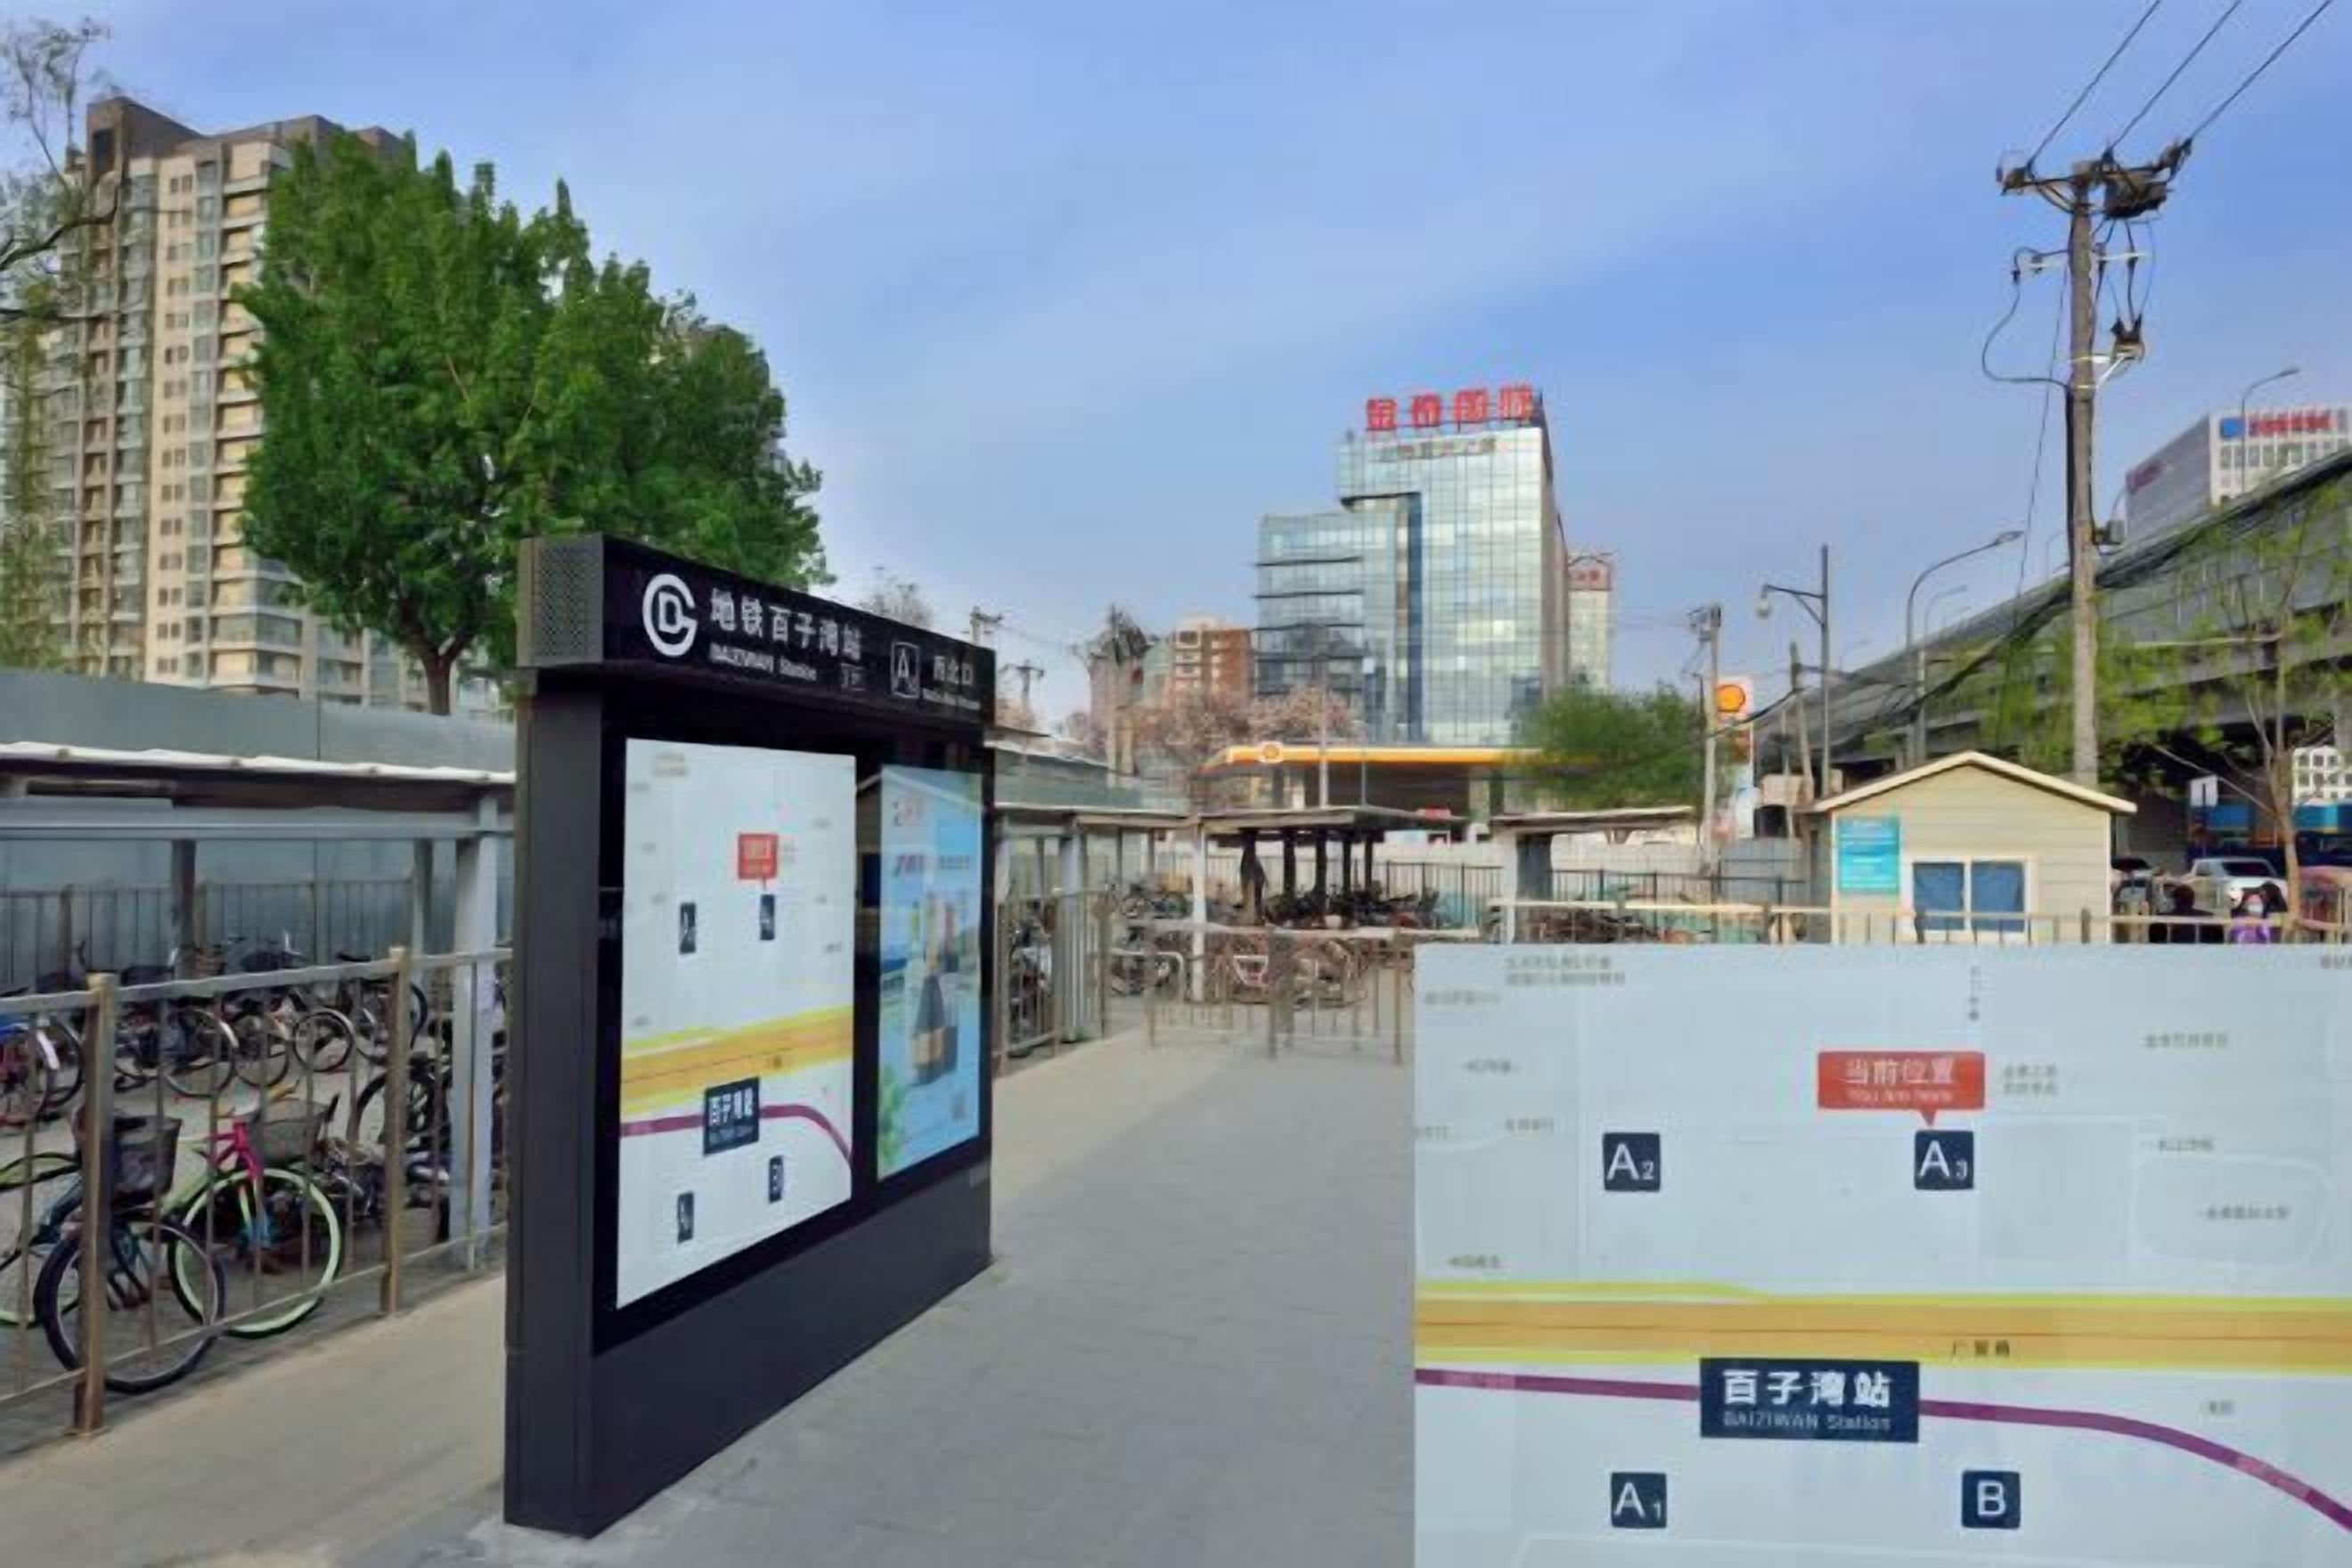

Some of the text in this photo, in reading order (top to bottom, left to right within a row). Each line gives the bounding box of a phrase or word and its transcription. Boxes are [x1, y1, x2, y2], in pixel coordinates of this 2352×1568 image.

[710, 586, 862, 661] 地铁百子湾站
[1721, 1369, 1892, 1408] 百子湾站
[1977, 1481, 2006, 1516] B
